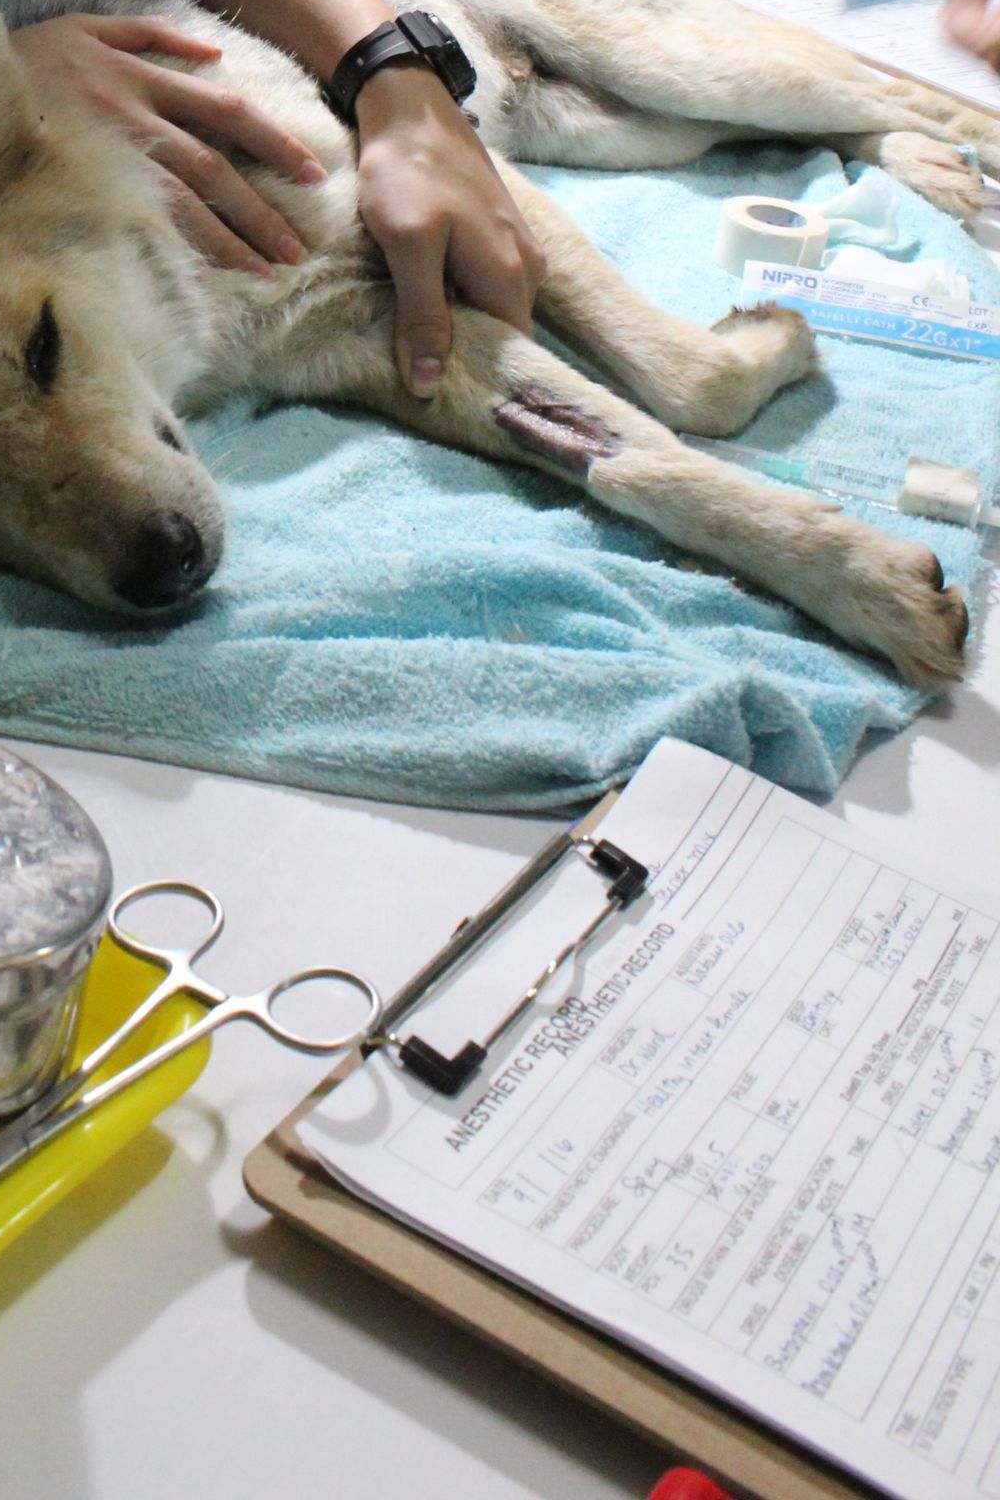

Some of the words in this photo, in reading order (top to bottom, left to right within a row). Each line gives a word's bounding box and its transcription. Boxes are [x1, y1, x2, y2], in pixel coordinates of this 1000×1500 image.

[762, 269, 819, 290] NIPRO
[864, 317, 897, 332] CATH
[551, 970, 631, 1058] ANESTHETIC
[621, 918, 676, 978] RECORD
[880, 1079, 904, 1108] DRUG
[939, 976, 964, 1009] ROUTE
[967, 933, 988, 959] TIME
[444, 1054, 533, 1153] ANESTHETIC
[523, 992, 587, 1062] RECORD
[871, 1037, 908, 1087] ANESTHETIC
[665, 1239, 696, 1274] 35
[725, 1218, 746, 1248] LAST
[738, 1301, 767, 1336] DRUG
[815, 1177, 843, 1214] ROUTE
[847, 1133, 868, 1159] TIME
